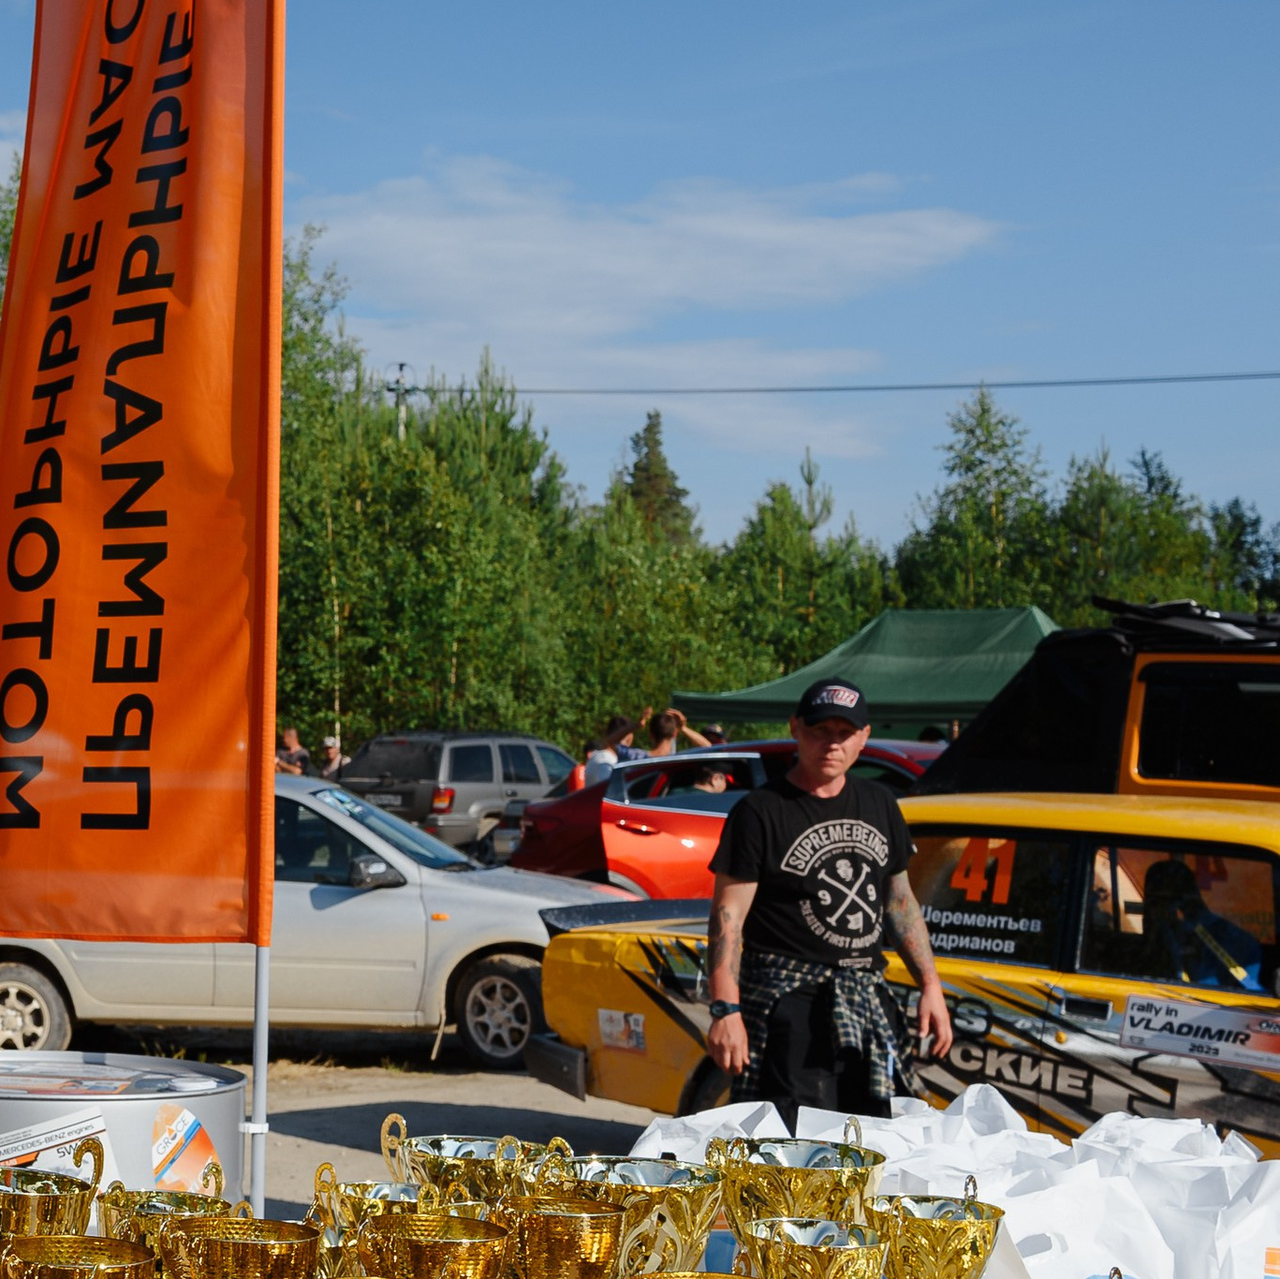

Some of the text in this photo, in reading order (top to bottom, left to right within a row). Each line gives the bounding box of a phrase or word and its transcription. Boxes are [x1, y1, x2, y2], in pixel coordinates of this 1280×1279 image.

[951, 837, 1016, 904] 41
[928, 932, 1015, 954] ндрианов
[1130, 1002, 1178, 1018] rally in
[1130, 1015, 1251, 1046] VLADIMIR
[1189, 1042, 1220, 1056] 2023
[0, 1131, 67, 1156] MERCEDES-BENZ
[67, 1124, 94, 1138] engines
